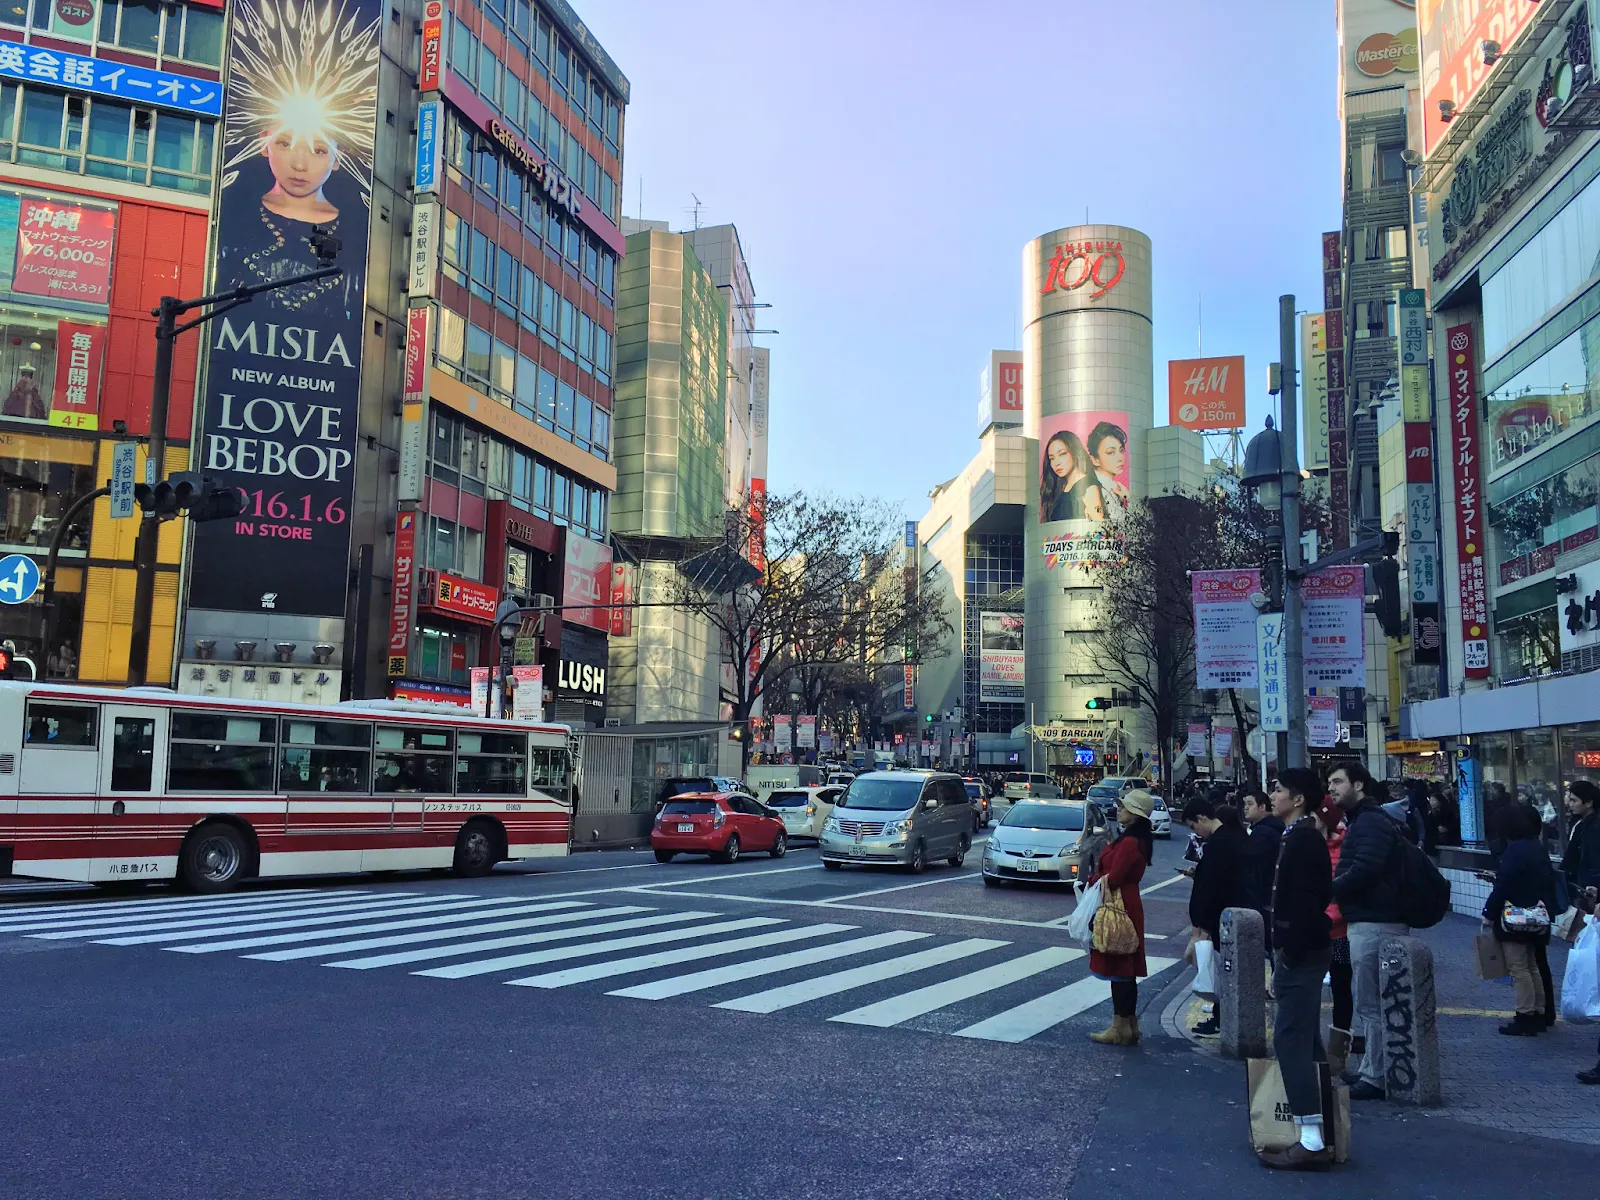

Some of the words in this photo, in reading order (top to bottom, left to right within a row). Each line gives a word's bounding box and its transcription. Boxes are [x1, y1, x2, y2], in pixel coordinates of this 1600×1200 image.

[61, 5, 90, 18] ガスト
[425, 37, 440, 82] ガスト
[24, 206, 82, 232] 沖縄
[414, 212, 429, 289] 渋谷駅前ビル
[1055, 241, 1123, 255] SHIBUYA
[22, 264, 77, 279] ドレスのまま
[1039, 251, 1126, 300] 109
[213, 316, 356, 368] MISIA
[65, 332, 92, 405] 毎日開催
[231, 367, 272, 386] NEW
[277, 374, 336, 393] ALBUM
[1184, 365, 1229, 396] H&M
[1201, 400, 1227, 410] この先
[1201, 410, 1236, 422] 150m
[61, 416, 87, 428] 4F
[217, 394, 342, 442] LOVE
[204, 434, 352, 482] BEBOP
[1408, 446, 1430, 459] JTB
[1454, 368, 1477, 541] ウィンターフルーツギフト
[120, 448, 133, 512] 渋谷駅前
[1411, 499, 1420, 529] パーラー
[1421, 494, 1430, 524] フルーツ
[235, 522, 254, 536] IN
[260, 524, 313, 541] STORE
[505, 518, 534, 543] COFFEE
[1045, 541, 1073, 554] 7DAYS
[570, 569, 601, 600] アコム
[1413, 559, 1424, 589] フルーツ
[440, 581, 451, 600] 薬
[1471, 555, 1487, 624] 無料配送地域
[391, 556, 412, 650] サンドラッグ
[462, 593, 496, 613] サンドラッグ
[579, 607, 590, 620] 3F
[193, 668, 329, 685] 渋谷駅前ビル
[390, 658, 405, 674] 薬
[558, 659, 605, 695] LUSH
[991, 663, 1015, 672] LOVES
[1002, 673, 1024, 681] AMURO
[1262, 623, 1280, 712] 文化村通り
[1264, 716, 1282, 725] 方面
[1060, 730, 1104, 738] BARGAIN
[758, 780, 787, 789] NITTSU
[425, 803, 482, 811] ノンステップバス
[109, 863, 158, 874] 小田急バス
